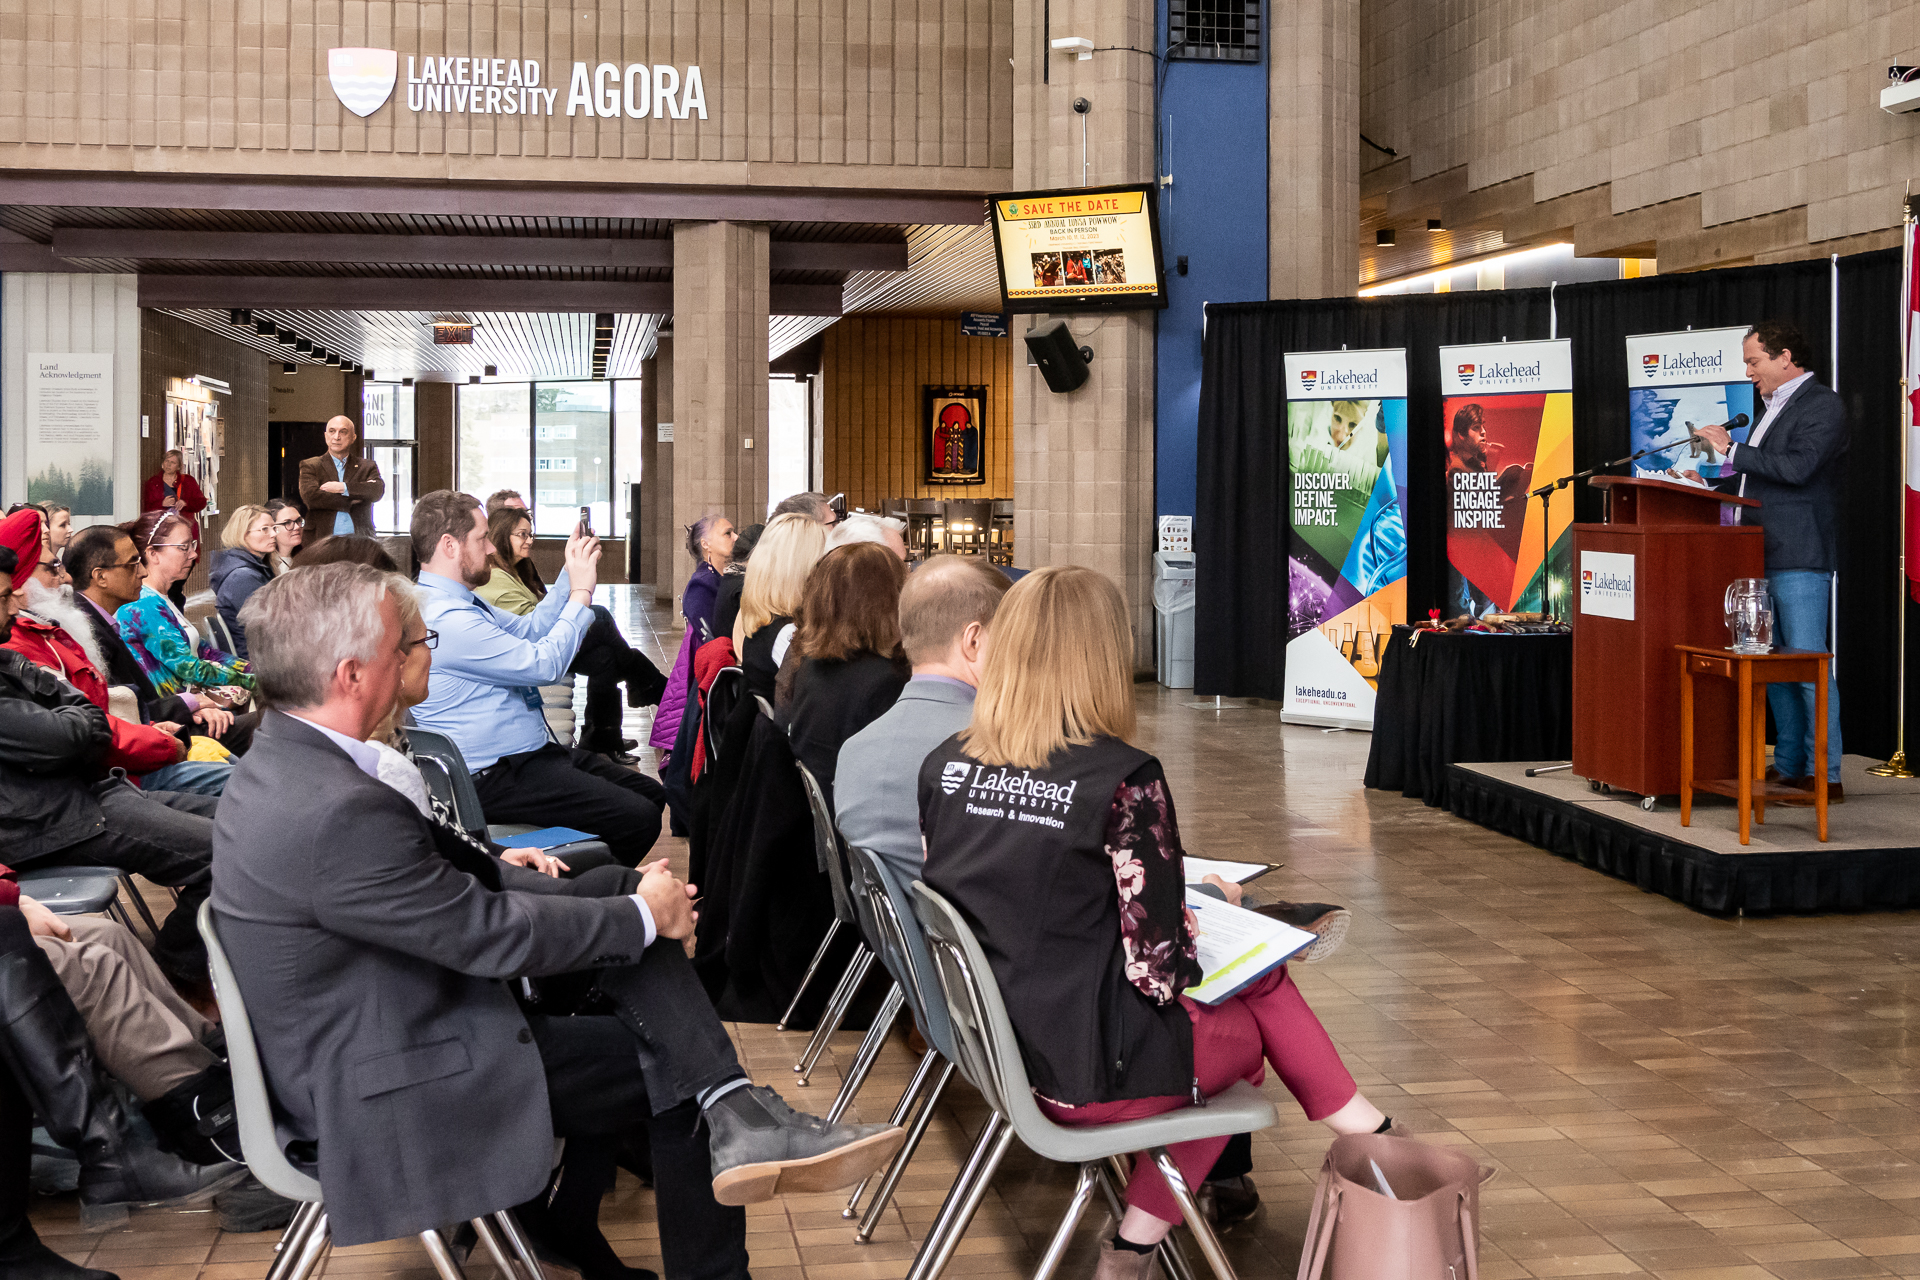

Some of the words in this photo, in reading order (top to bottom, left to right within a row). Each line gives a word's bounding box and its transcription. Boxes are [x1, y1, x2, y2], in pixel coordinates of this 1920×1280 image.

[408, 56, 540, 87] LAKEHEAD
[408, 84, 558, 116] UNIVERSITY
[566, 62, 708, 120] AGORA
[1023, 203, 1053, 215] SAVE
[1059, 201, 1082, 212] THE
[1088, 199, 1119, 210] DATE
[1089, 216, 1117, 225] POWWOW
[435, 326, 472, 341] EXIT
[1663, 350, 1722, 370] Lakehead
[39, 371, 102, 380] Acknowledgment
[1321, 369, 1378, 384] Lakehead
[1479, 361, 1540, 378] Lakehead
[1663, 368, 1723, 377] UNIVERSITY
[1479, 377, 1541, 385] UNIVERSITY
[1294, 472, 1352, 490] DISCOVER.
[1454, 472, 1501, 490] CREATE.
[1294, 490, 1337, 508] DEFINE.
[1454, 491, 1504, 510] ENGAGE.
[1294, 508, 1338, 527] IMPACT.
[1454, 511, 1505, 529] INSPIRE.
[1594, 572, 1631, 592] Lakehead
[1594, 590, 1632, 599] UNIVERSITY
[1295, 685, 1347, 700] lakeheadu.ca
[970, 765, 1077, 804] Lakehead
[968, 789, 1071, 814] UNIVERSITY
[966, 803, 1004, 818] Research
[1008, 809, 1016, 820] &
[1018, 811, 1065, 829] Innovation
